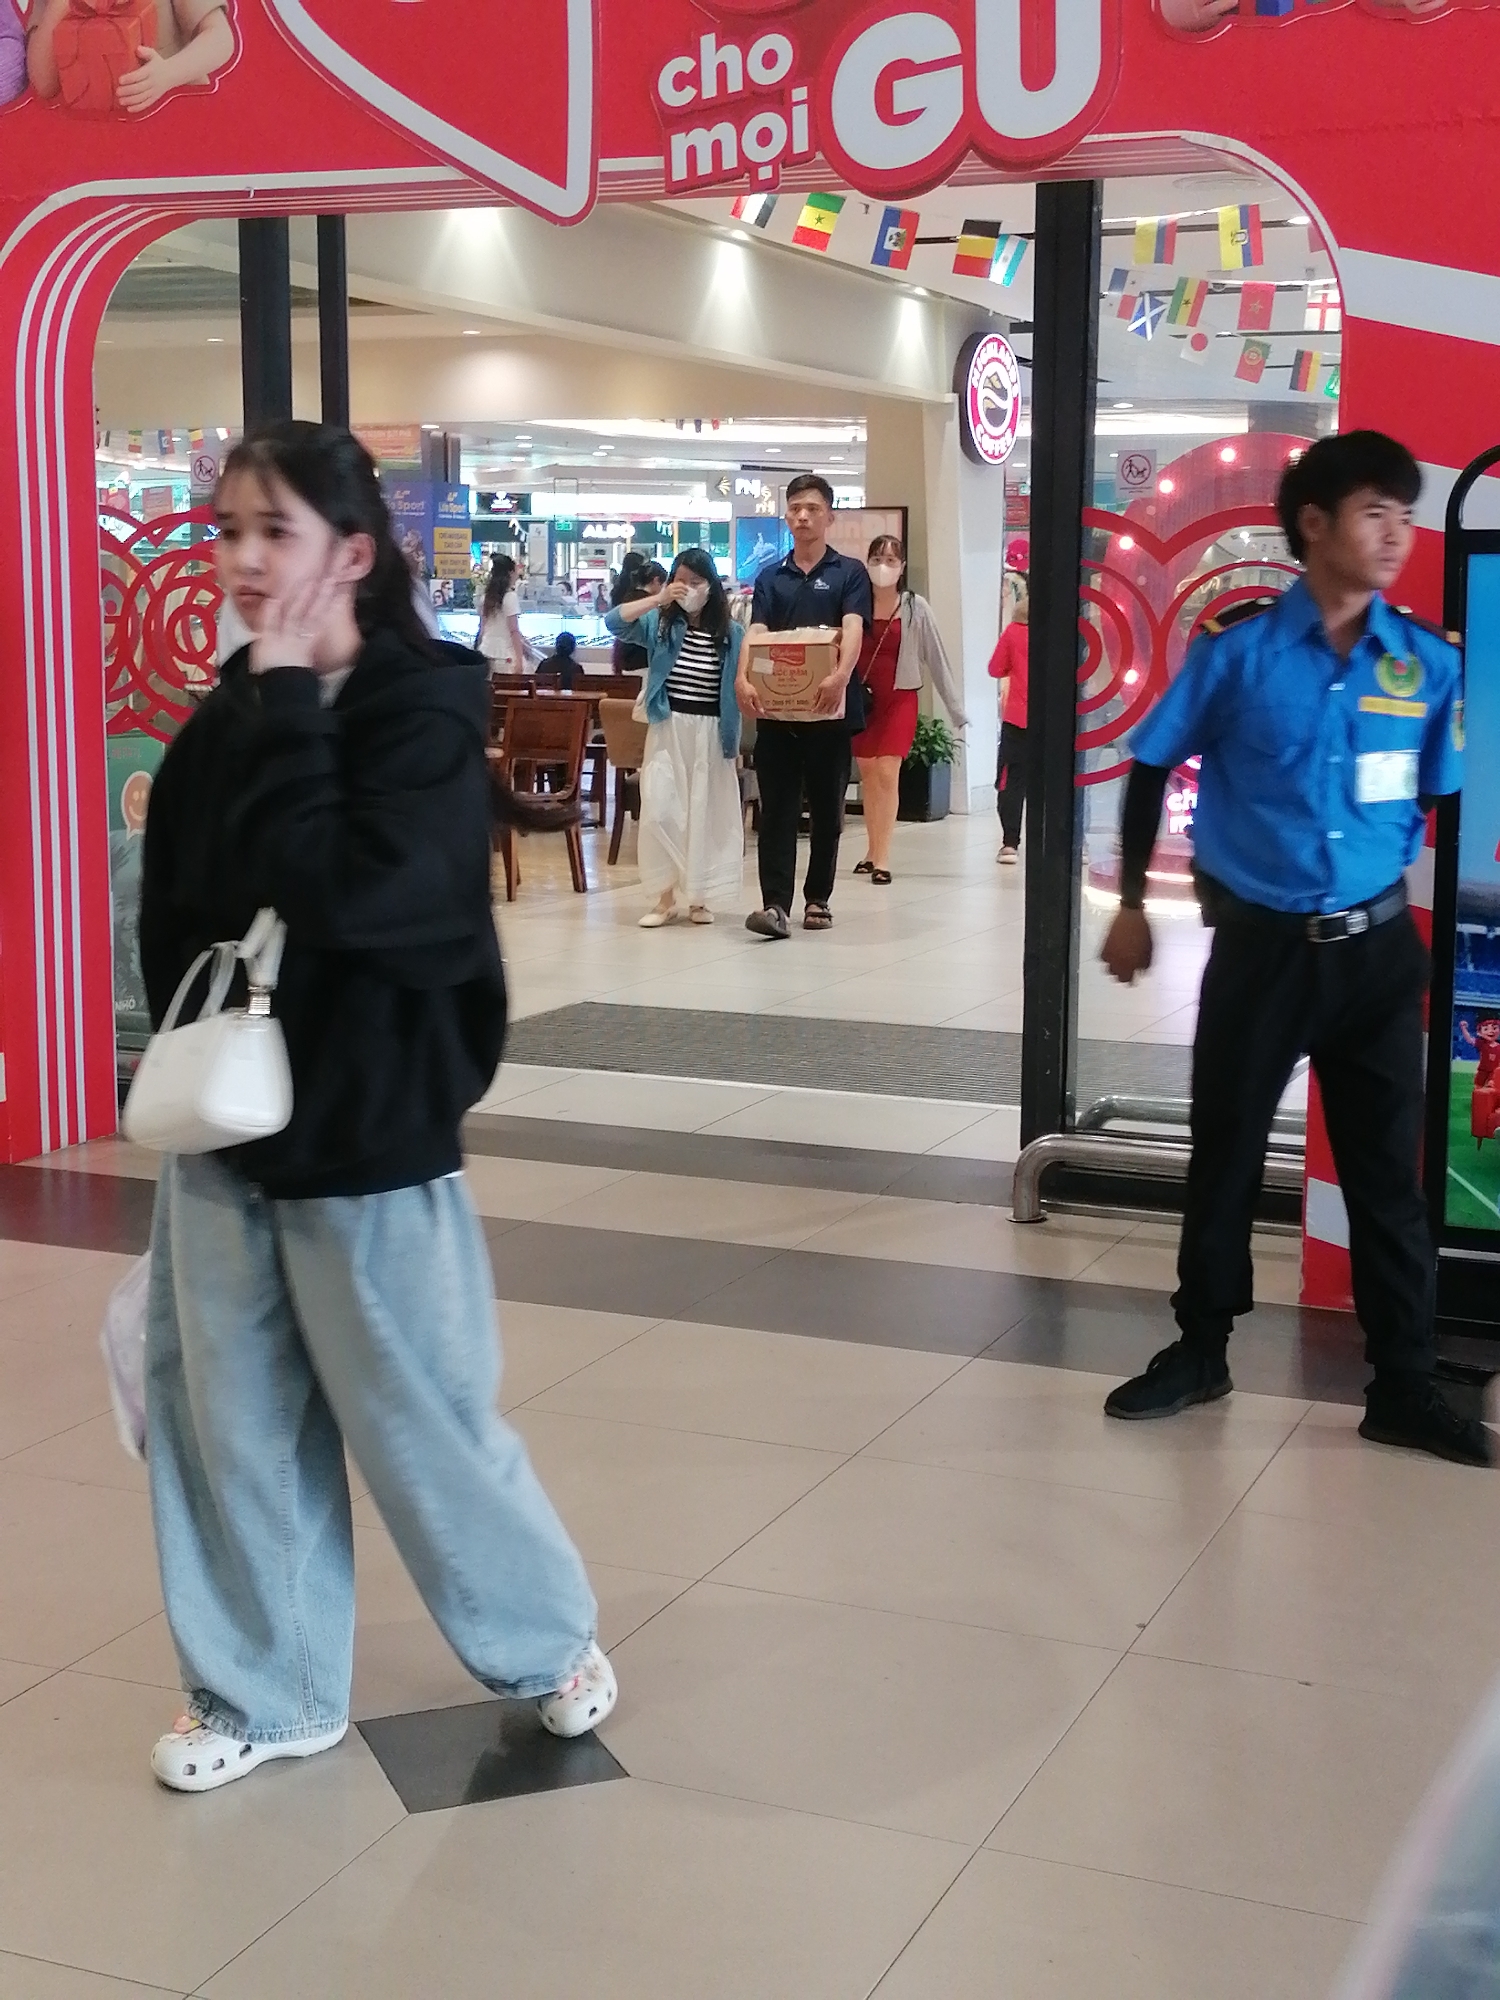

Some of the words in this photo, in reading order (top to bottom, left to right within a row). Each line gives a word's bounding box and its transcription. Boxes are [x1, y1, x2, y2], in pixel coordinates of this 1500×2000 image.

[657, 33, 793, 107] cho
[831, 0, 1101, 169] GU
[671, 86, 808, 181] mọi
[582, 523, 635, 539] ALDO
